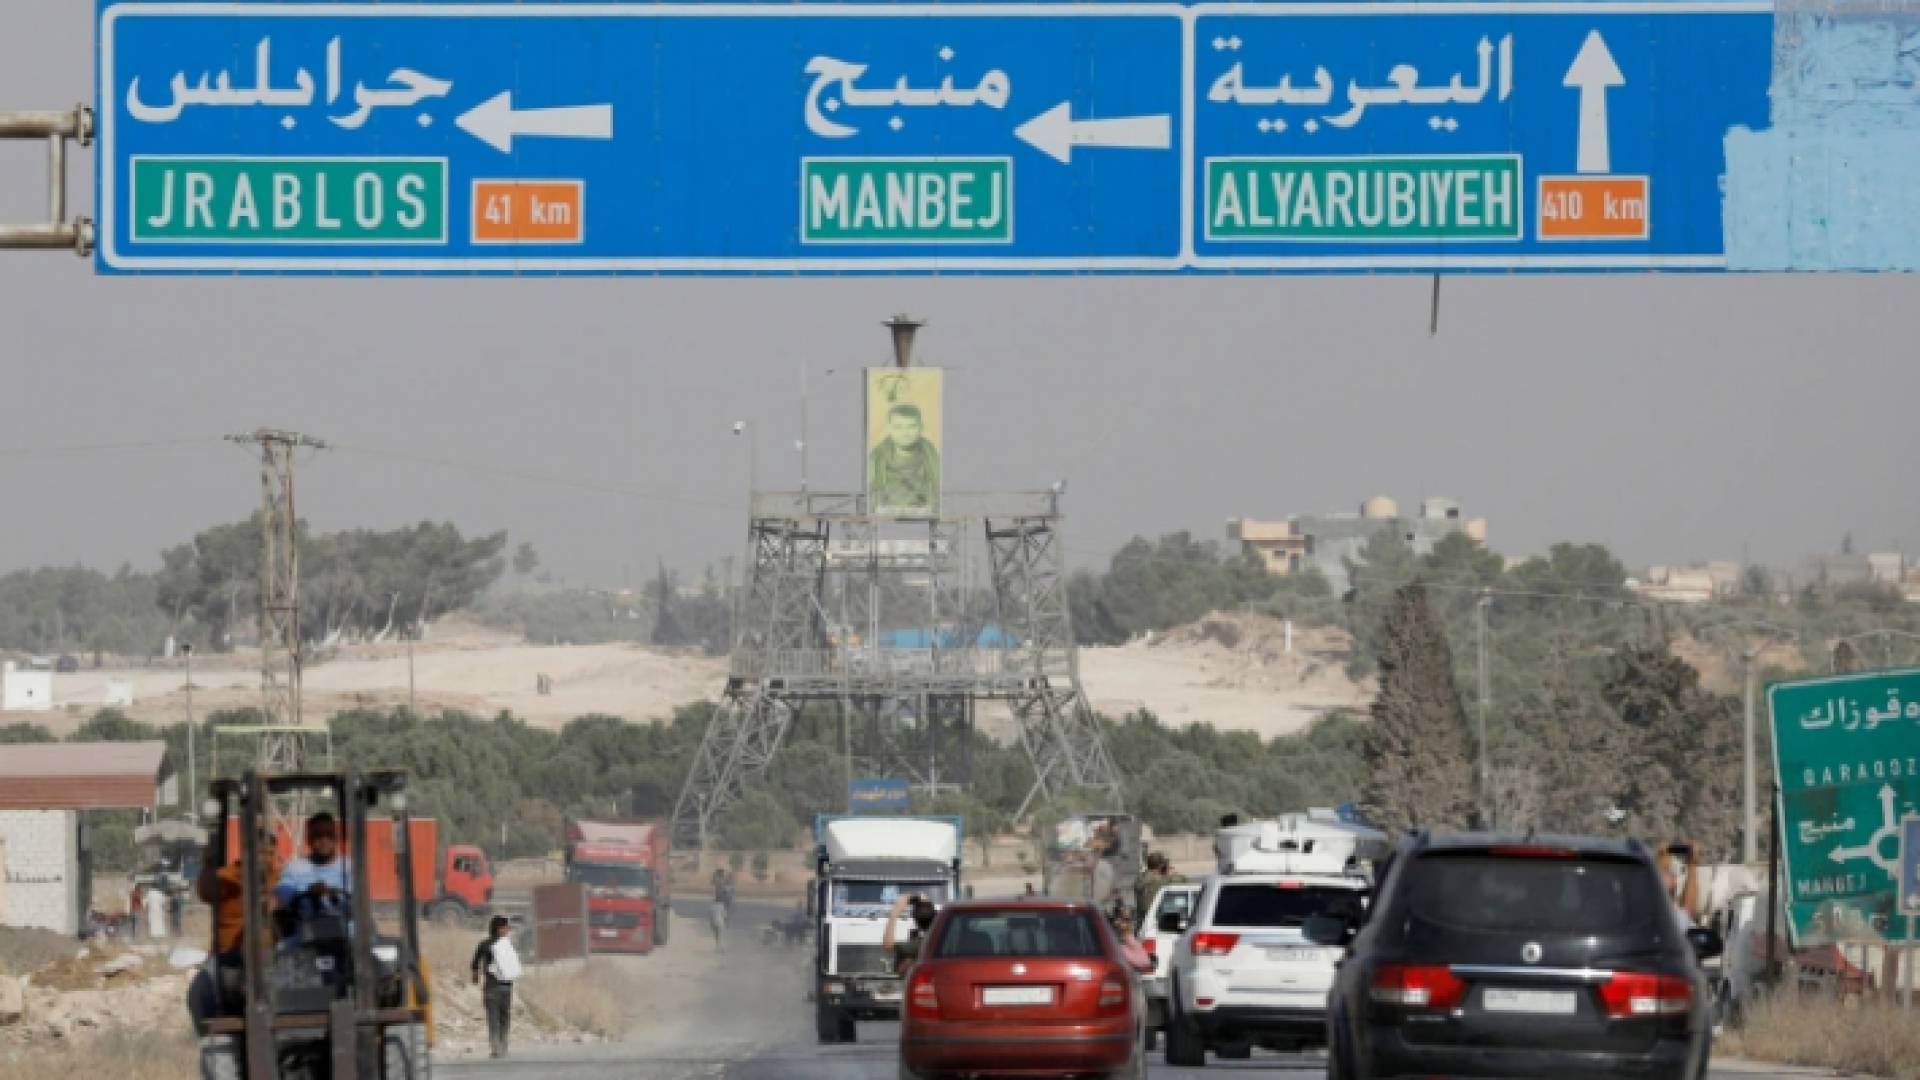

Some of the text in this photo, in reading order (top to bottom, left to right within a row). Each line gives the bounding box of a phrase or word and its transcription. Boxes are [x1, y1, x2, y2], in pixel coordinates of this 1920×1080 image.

[127, 37, 452, 129] جرابلس
[804, 46, 1011, 138] منبج
[1207, 34, 1514, 133] اليعربية
[147, 170, 426, 229] JRABLOS
[484, 194, 572, 225] 41 km
[809, 172, 1003, 229] MANBEJ
[1214, 169, 1513, 228] ALYARUBIYEH
[1542, 189, 1643, 221] 410 km
